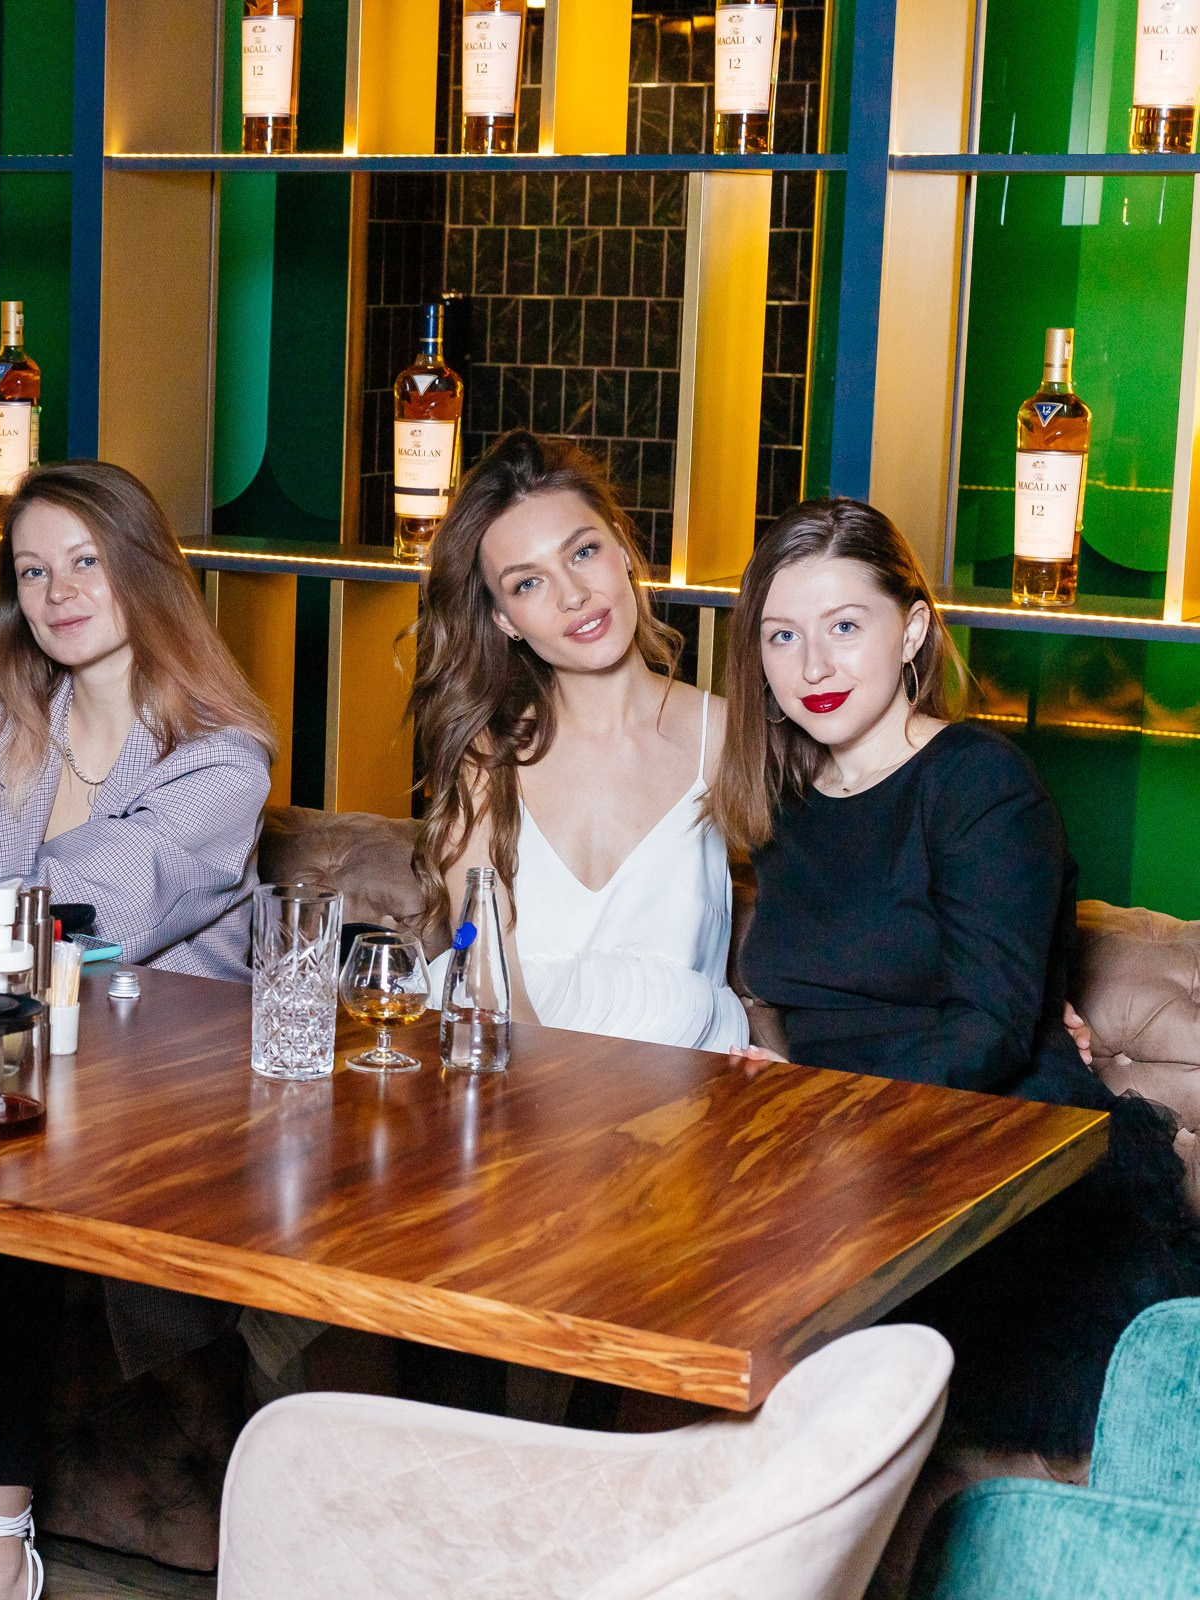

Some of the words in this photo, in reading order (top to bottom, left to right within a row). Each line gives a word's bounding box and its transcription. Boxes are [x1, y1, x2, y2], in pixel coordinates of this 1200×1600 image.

[1142, 25, 1198, 35] MACALAN
[716, 35, 763, 46] MACALLN
[243, 44, 283, 54] MACALLN
[476, 62, 488, 74] 12
[728, 57, 741, 69] 12
[252, 65, 264, 76] 12
[1042, 405, 1052, 415] 12
[398, 447, 442, 457] MACALLAN
[1018, 480, 1068, 492] MACALLAN
[1031, 504, 1045, 517] 12
